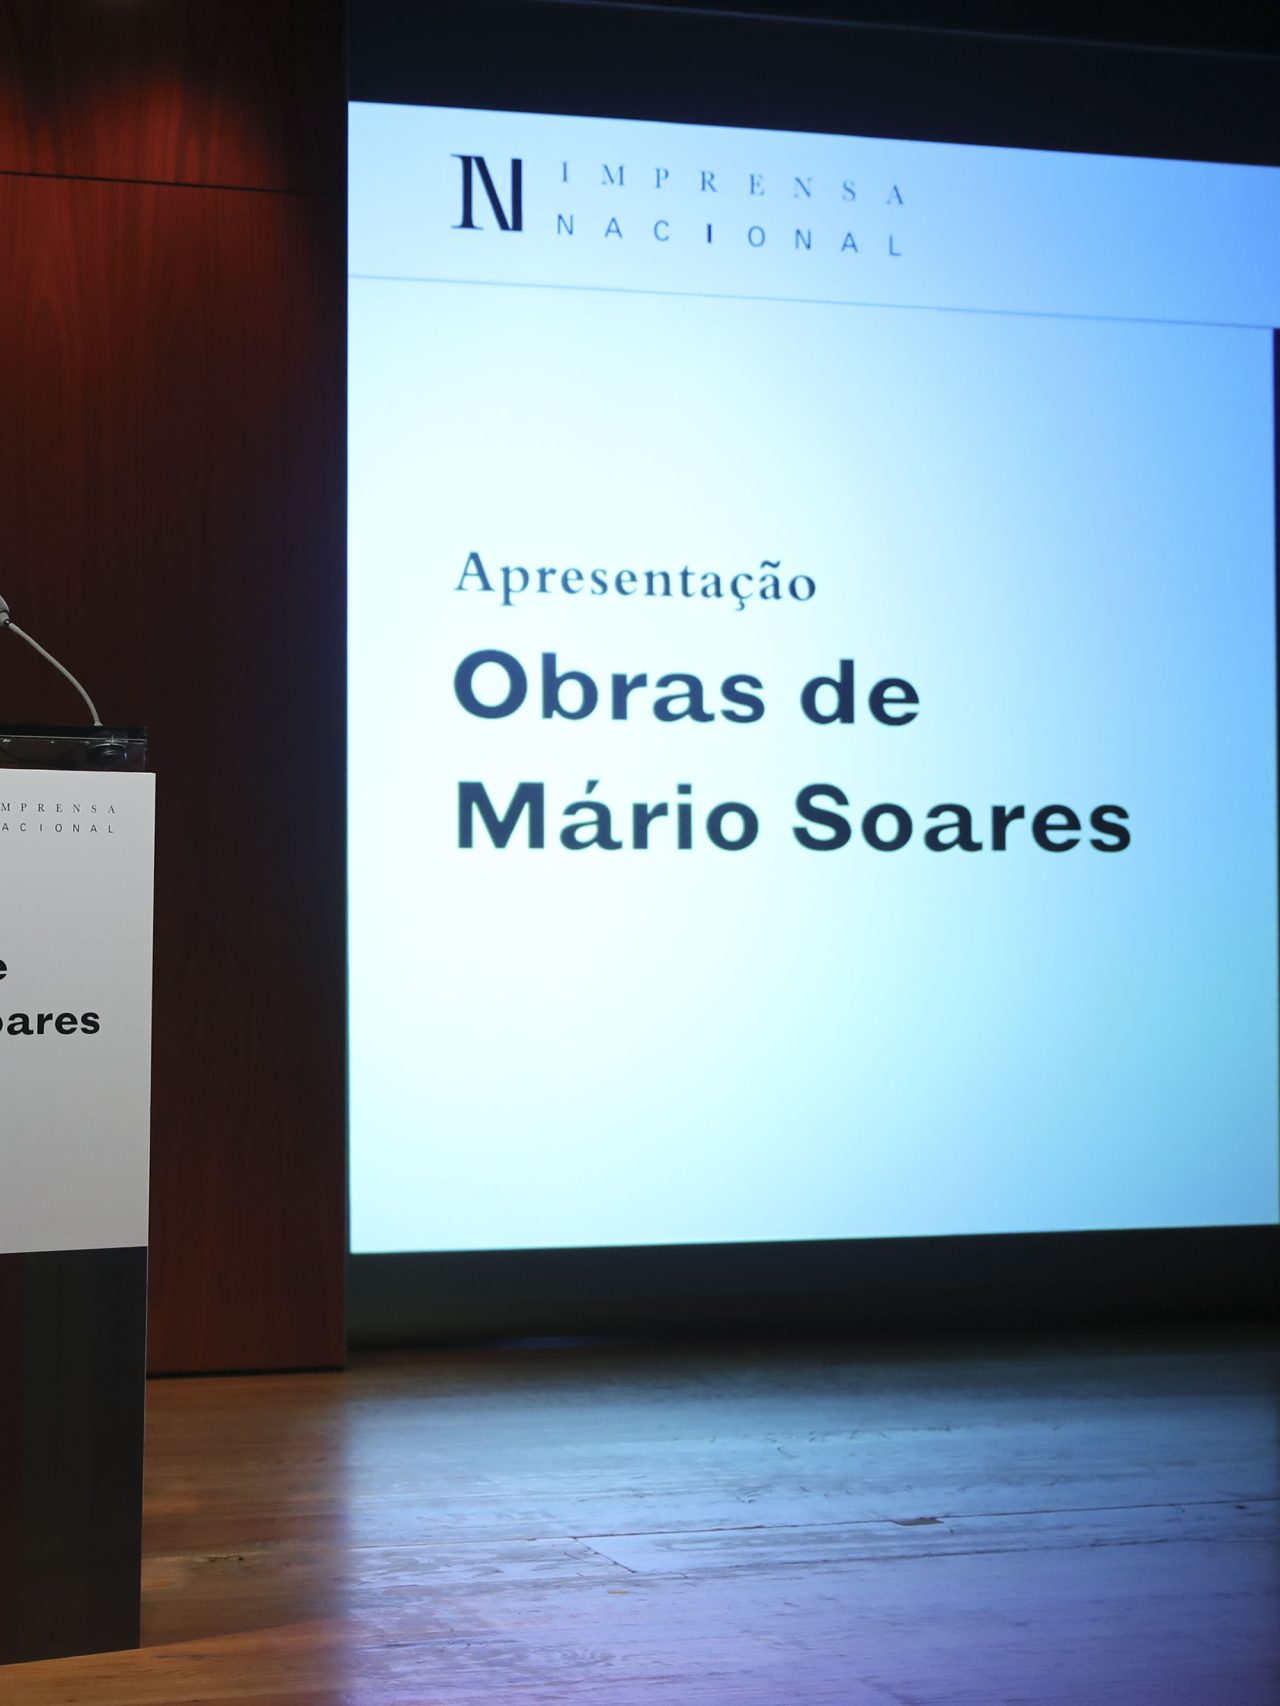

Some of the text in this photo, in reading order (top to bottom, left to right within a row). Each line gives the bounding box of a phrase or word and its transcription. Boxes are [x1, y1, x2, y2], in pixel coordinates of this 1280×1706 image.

[562, 161, 903, 205] IMPRENSA
[557, 214, 901, 256] NACIONAL
[455, 552, 816, 611] Apresentação
[454, 649, 919, 726] Obras de
[458, 780, 1130, 852] Mário Soares
